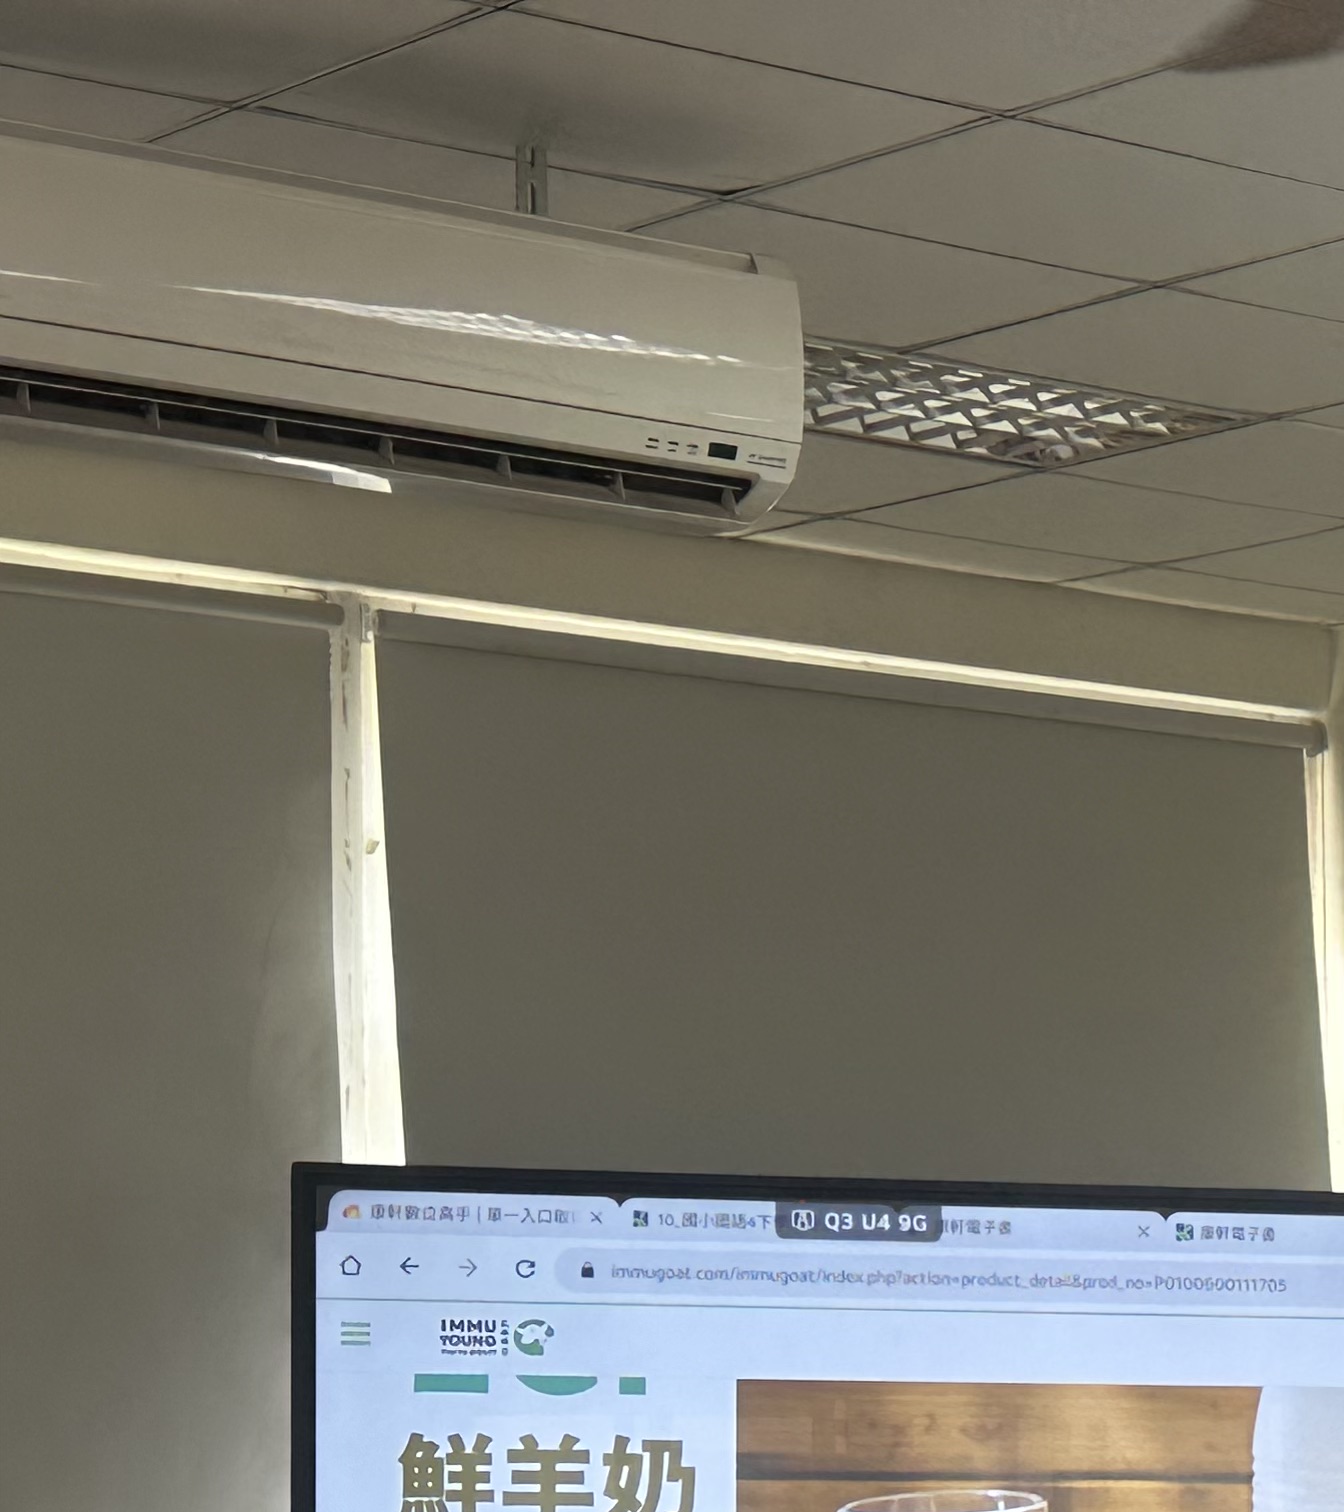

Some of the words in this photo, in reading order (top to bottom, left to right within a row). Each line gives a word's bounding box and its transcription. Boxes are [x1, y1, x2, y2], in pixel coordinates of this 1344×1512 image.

[824, 1212, 854, 1233] Q3
[861, 1213, 892, 1232] U4
[897, 1214, 928, 1234] 9G
[440, 1318, 497, 1333] IMMU
